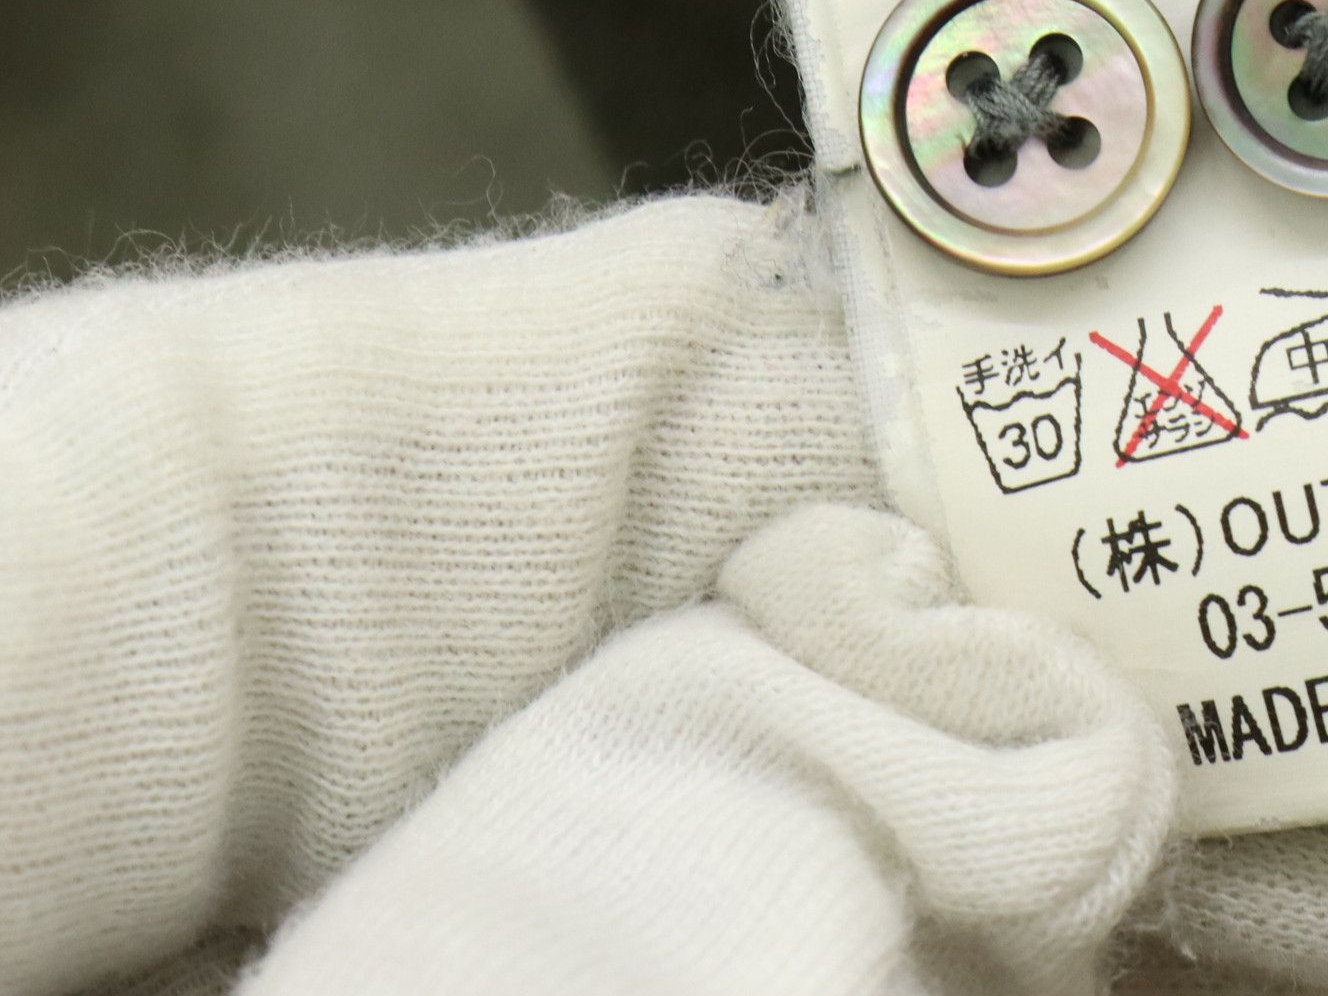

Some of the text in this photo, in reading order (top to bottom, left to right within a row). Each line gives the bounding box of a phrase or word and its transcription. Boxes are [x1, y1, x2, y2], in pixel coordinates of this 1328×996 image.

[961, 336, 1067, 395] 手洗イ
[998, 413, 1064, 470] 30
